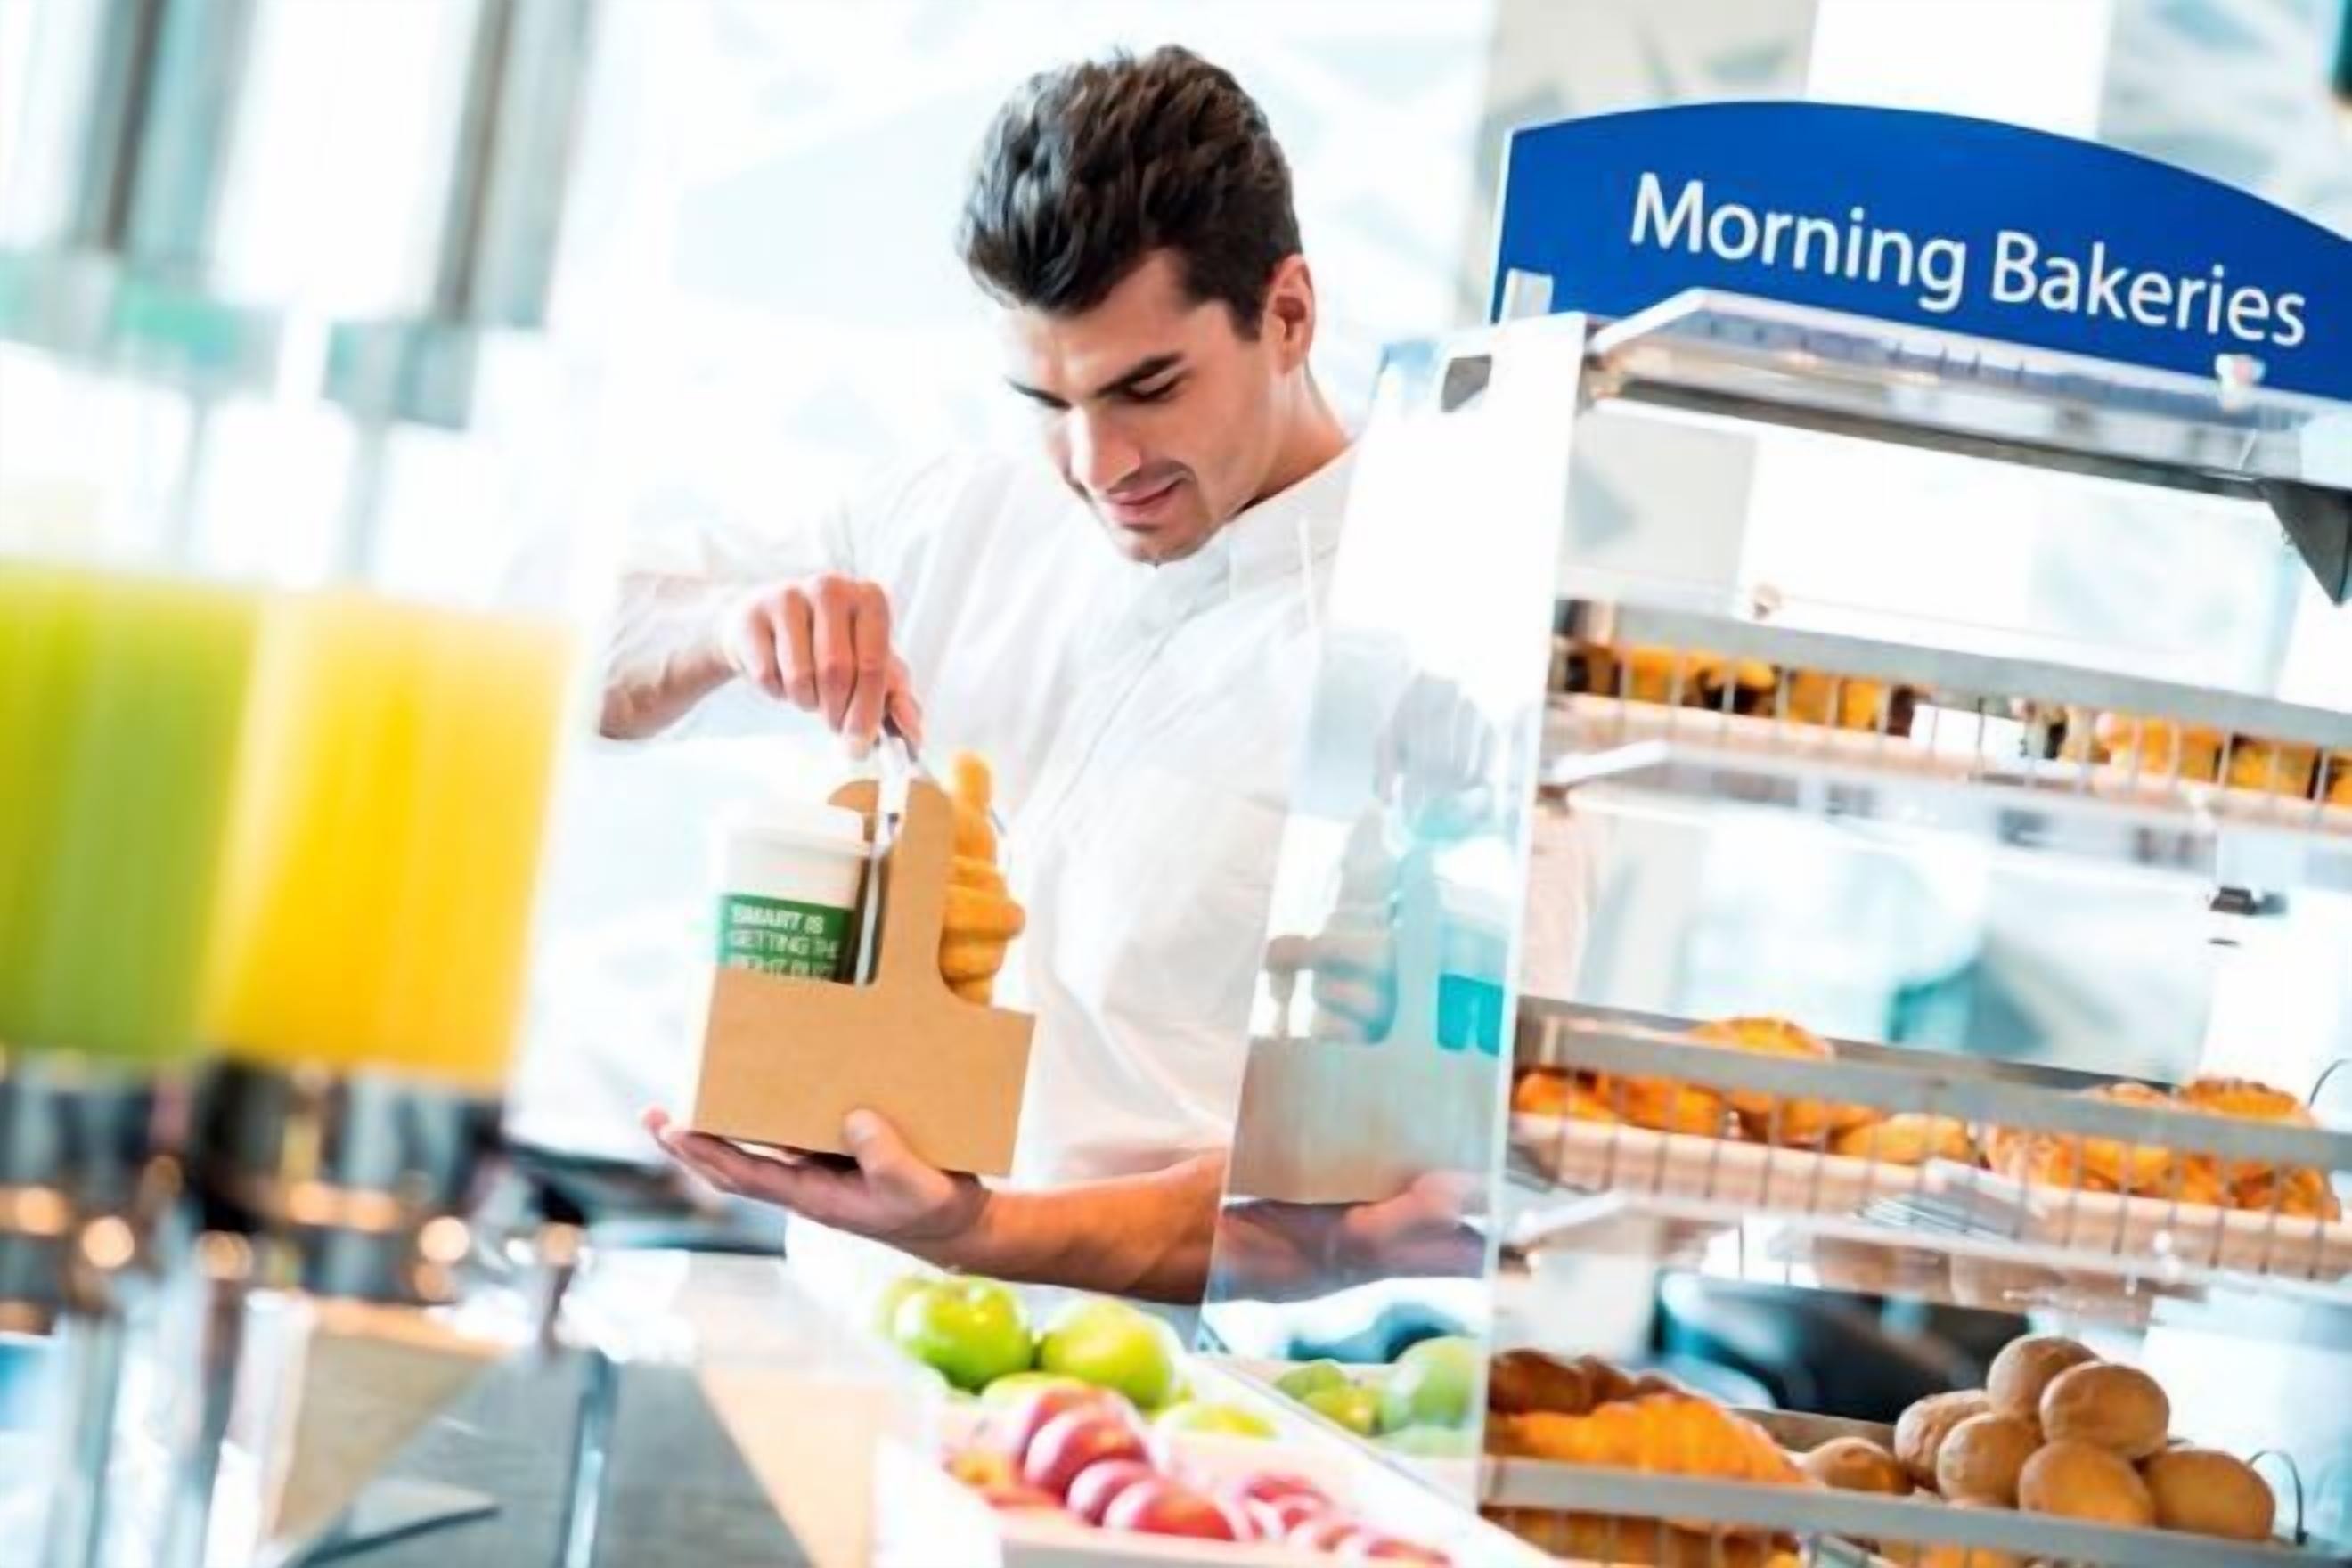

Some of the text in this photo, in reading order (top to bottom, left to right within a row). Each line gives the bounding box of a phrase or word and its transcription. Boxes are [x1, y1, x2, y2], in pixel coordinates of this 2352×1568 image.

[1630, 173, 2306, 347] Morning Bakeries
[731, 904, 825, 935] SMART IS
[731, 928, 810, 956] GETTING
